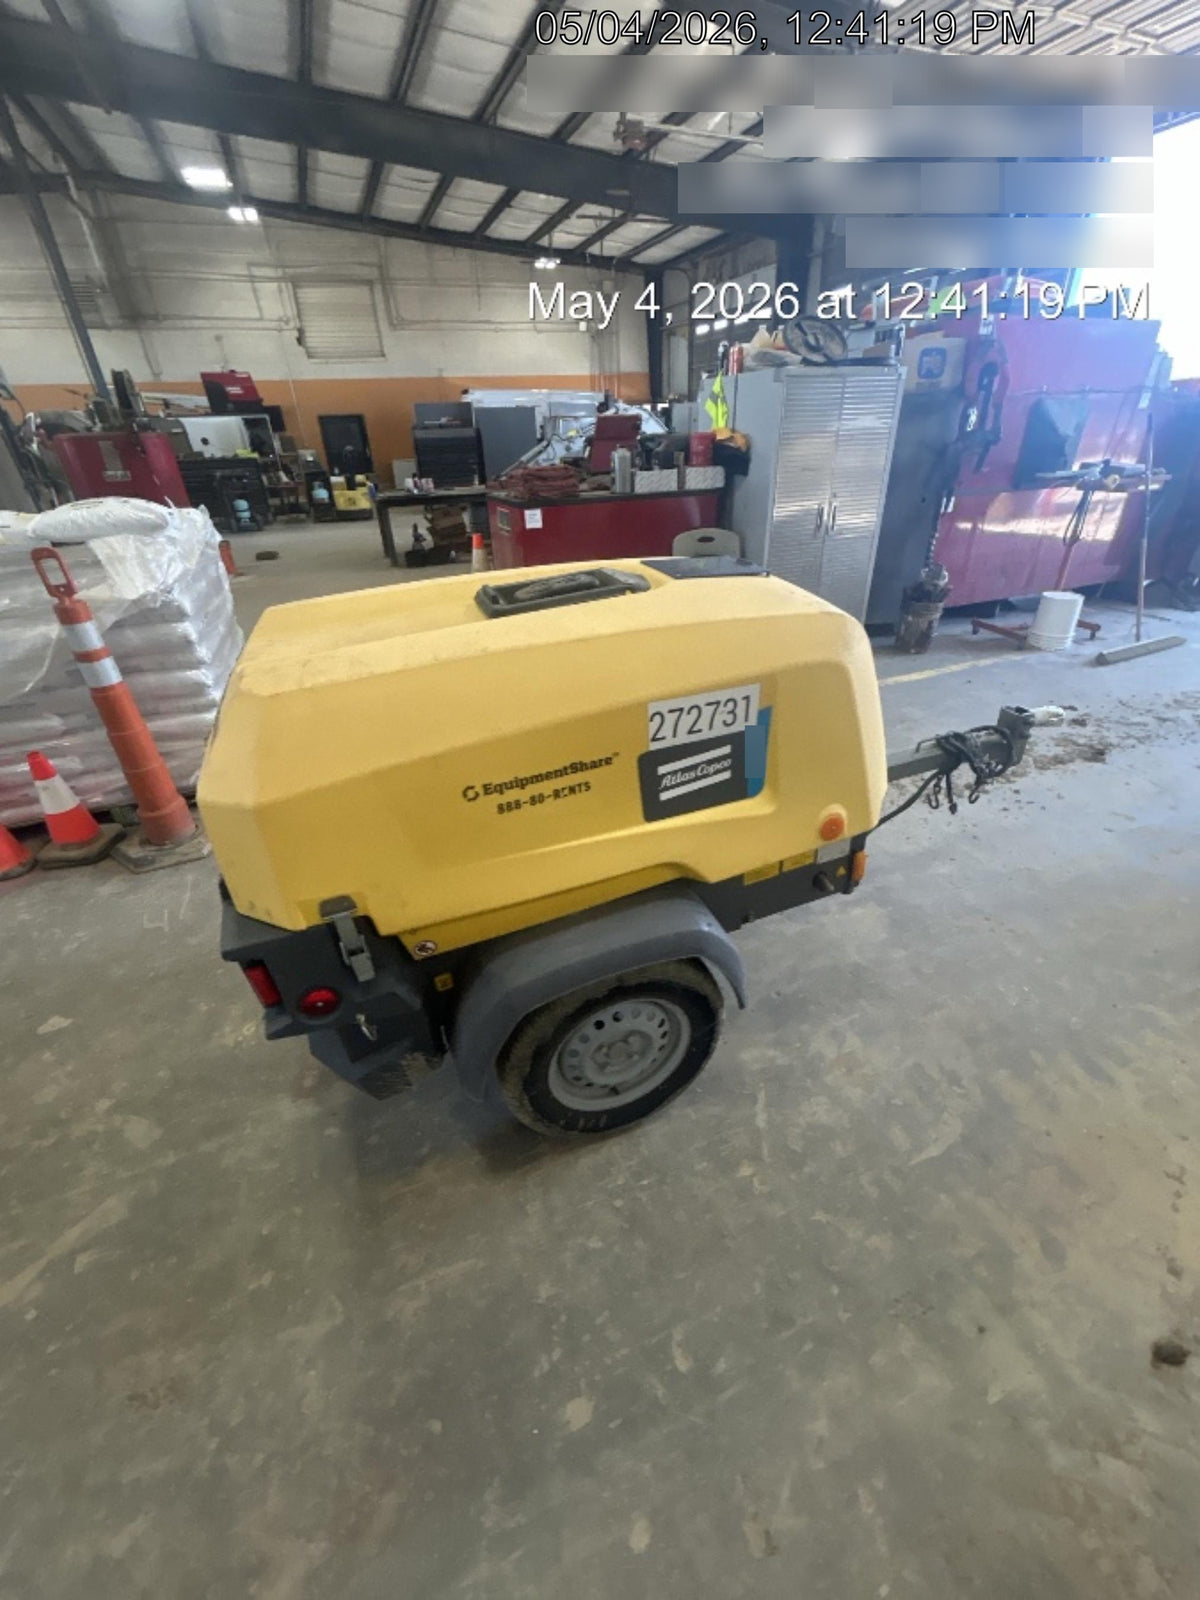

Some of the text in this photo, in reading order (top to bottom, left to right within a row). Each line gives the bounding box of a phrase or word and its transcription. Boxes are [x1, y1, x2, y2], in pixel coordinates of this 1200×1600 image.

[649, 694, 752, 743] 272731
[659, 758, 732, 790] Atlas Copco
